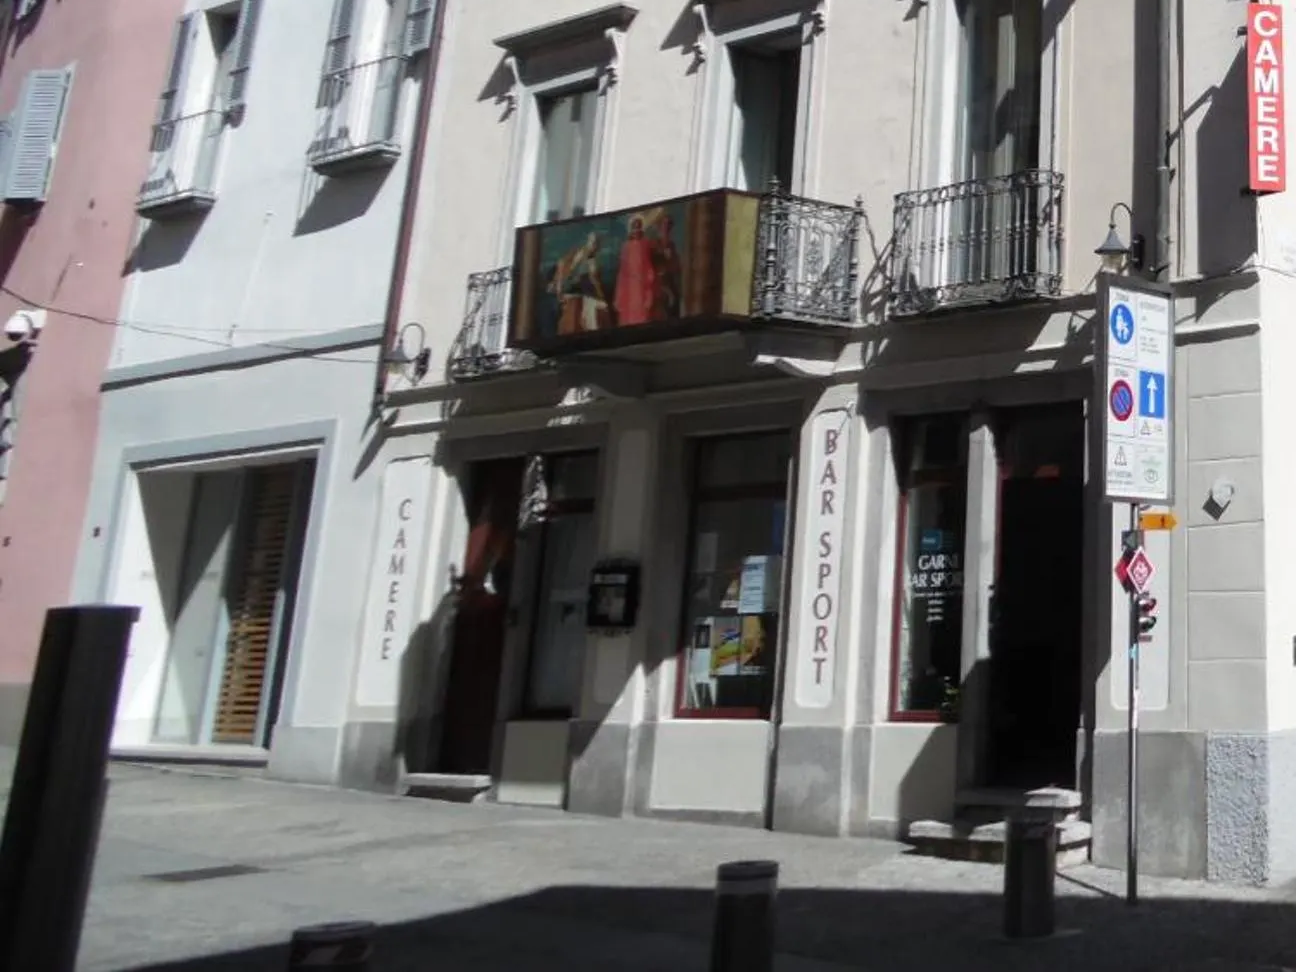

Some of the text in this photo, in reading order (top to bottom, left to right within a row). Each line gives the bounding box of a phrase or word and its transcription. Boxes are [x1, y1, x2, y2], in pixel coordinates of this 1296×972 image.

[1254, 11, 1279, 182] CAMERE
[381, 499, 413, 660] CAMERE
[812, 429, 838, 684] BAR SPORT
